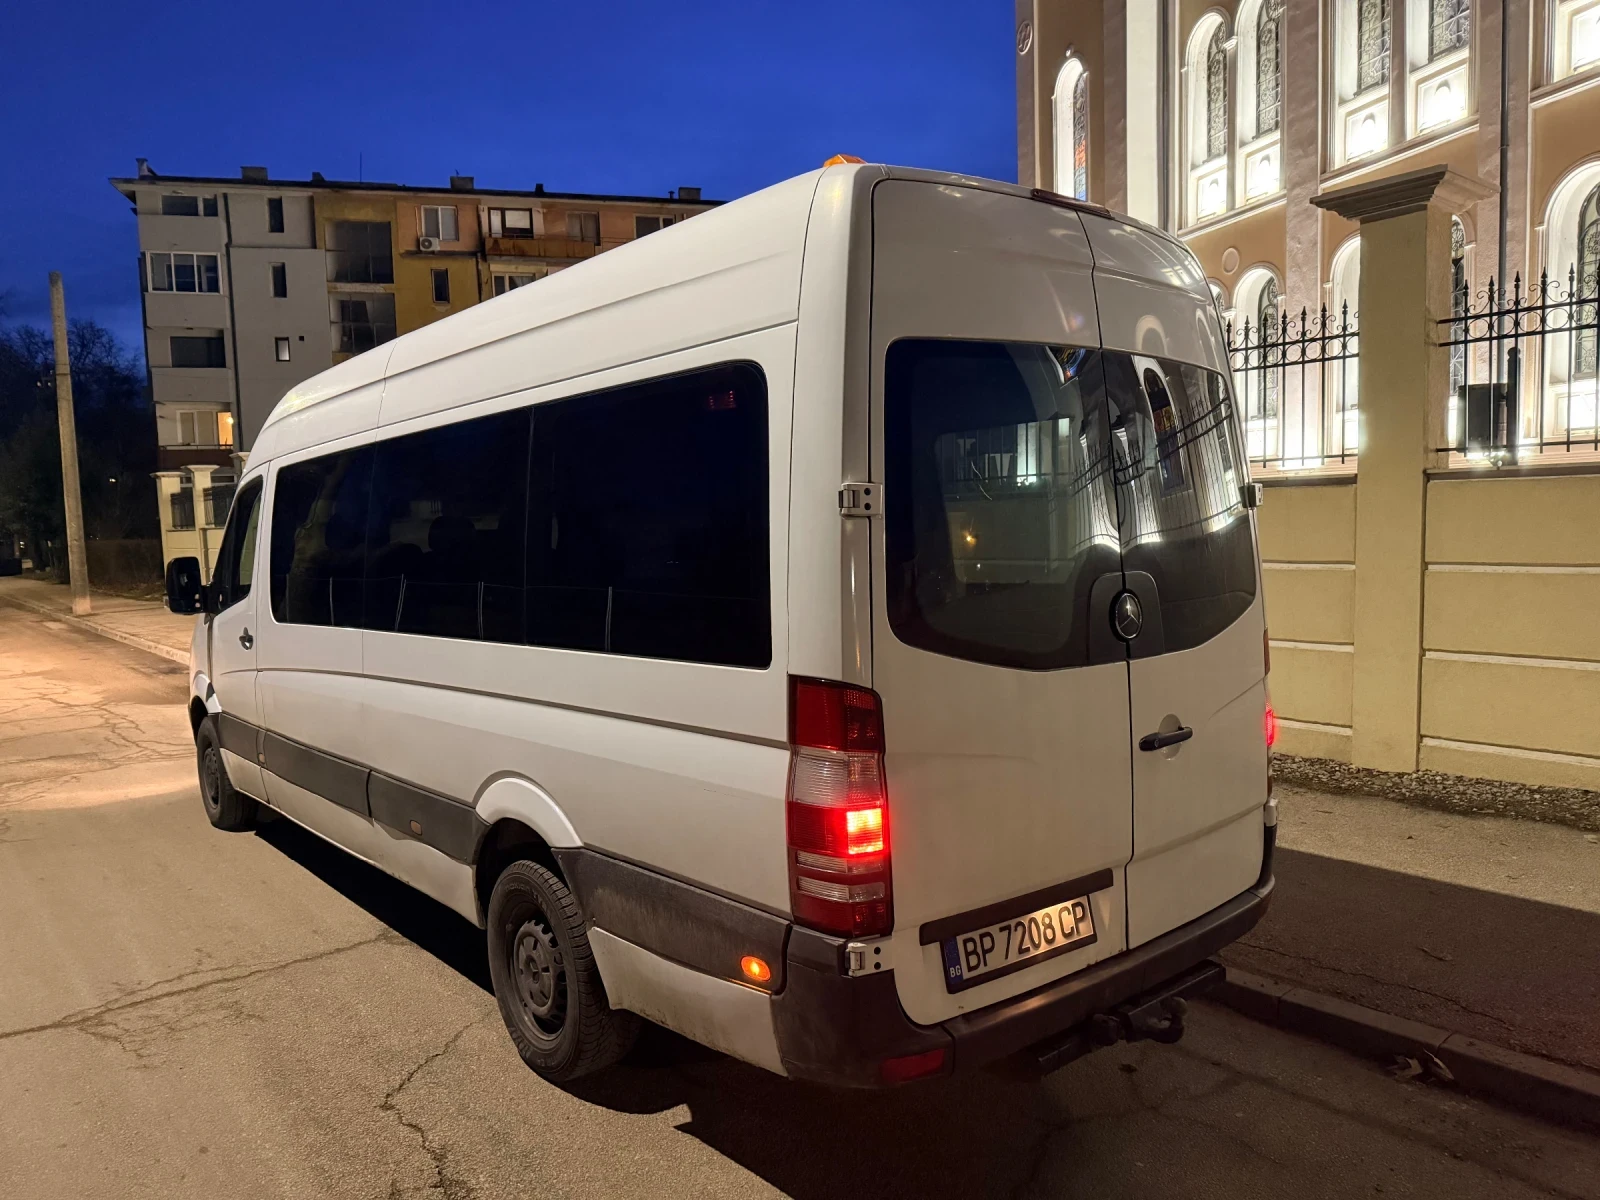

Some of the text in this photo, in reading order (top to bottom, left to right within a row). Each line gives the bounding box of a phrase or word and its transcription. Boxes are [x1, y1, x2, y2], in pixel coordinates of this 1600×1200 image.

[962, 901, 1086, 973] BP 7208 CP
[950, 965, 962, 978] BG
